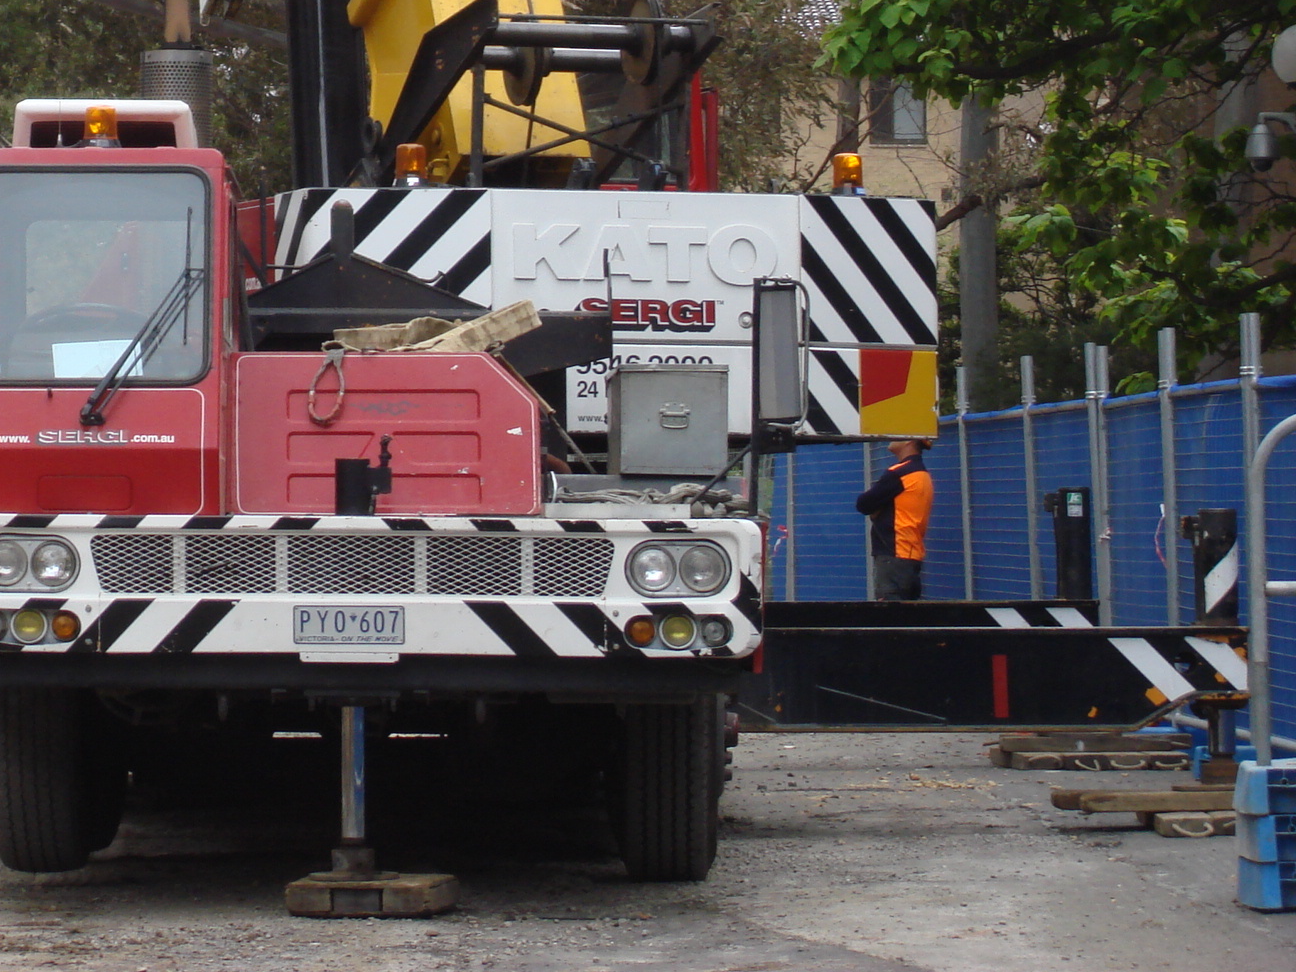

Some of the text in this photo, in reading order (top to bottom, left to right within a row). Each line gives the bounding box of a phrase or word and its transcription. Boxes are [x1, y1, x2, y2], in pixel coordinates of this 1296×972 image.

[512, 222, 778, 288] KATO
[577, 380, 599, 398] 24
[36, 429, 128, 447] SERGI
